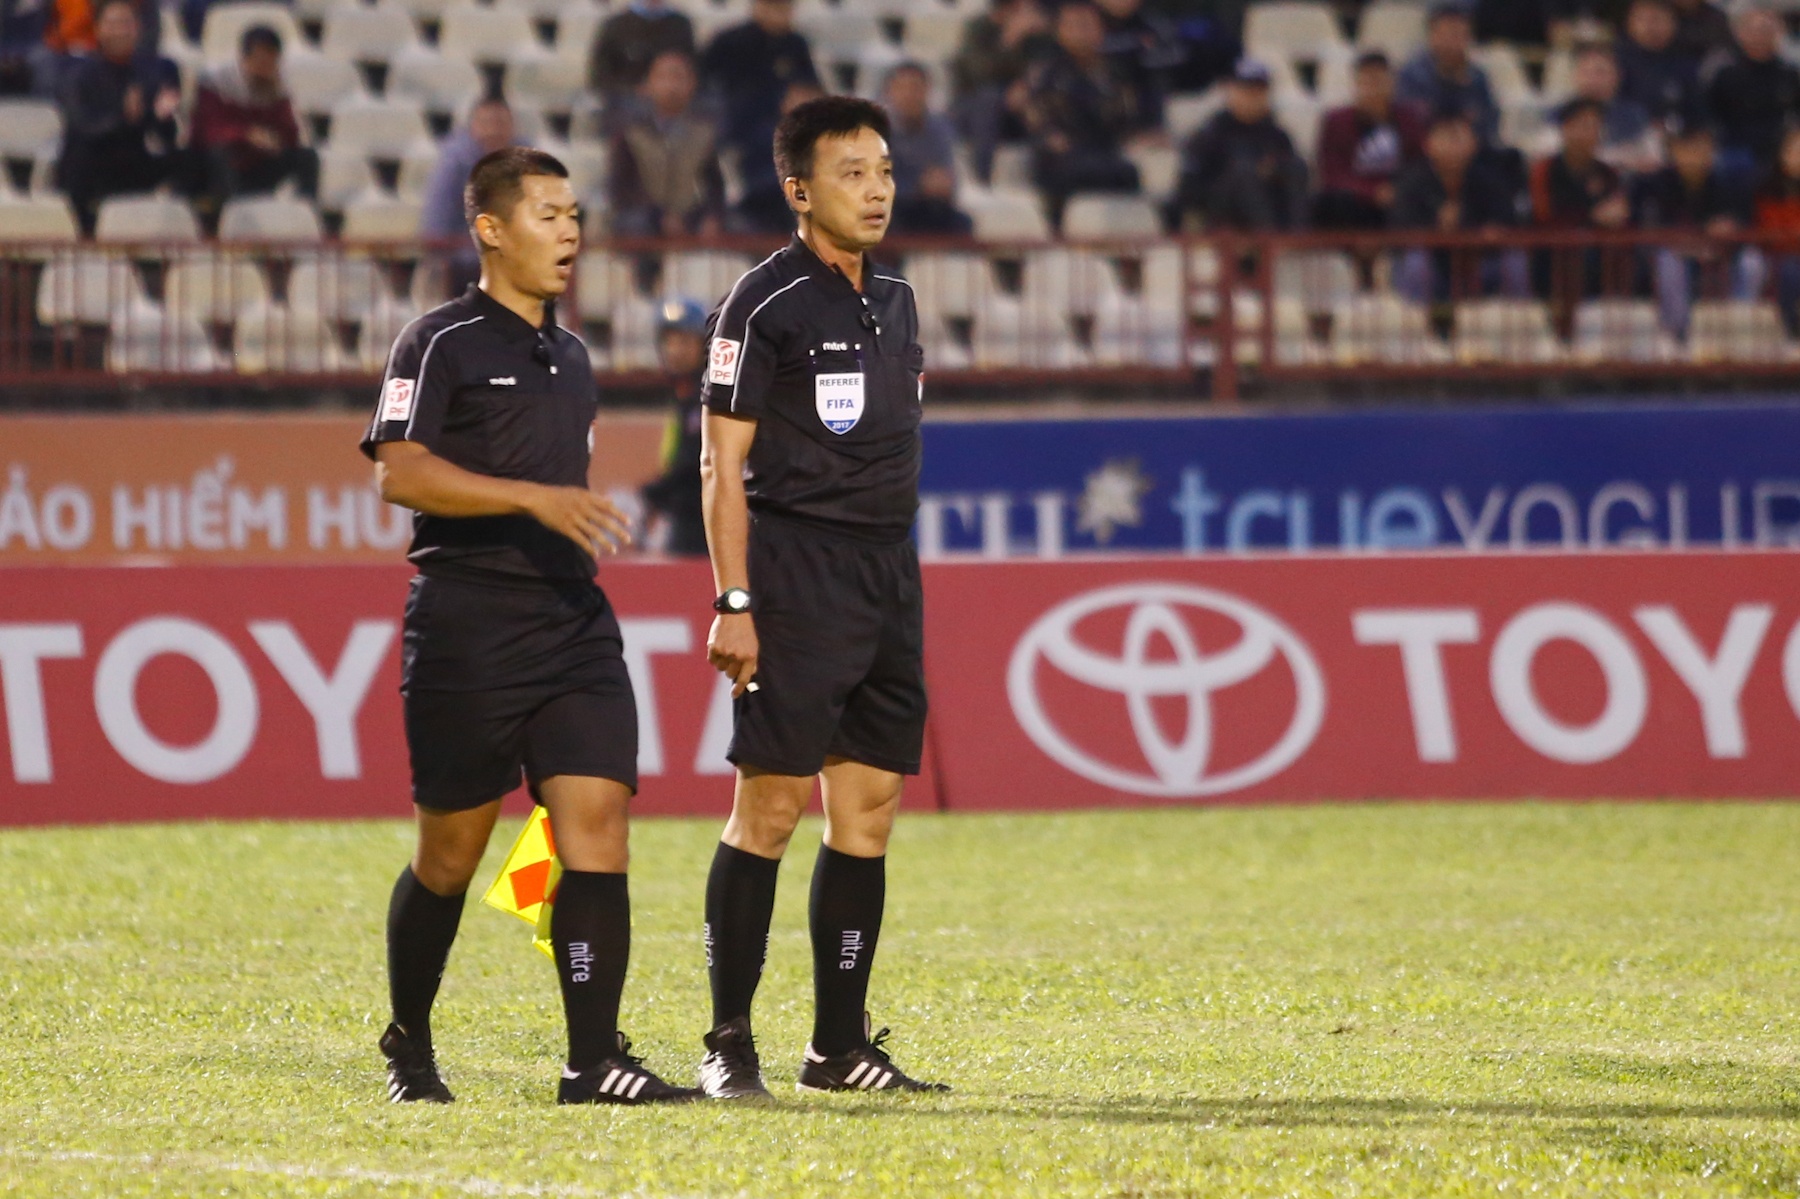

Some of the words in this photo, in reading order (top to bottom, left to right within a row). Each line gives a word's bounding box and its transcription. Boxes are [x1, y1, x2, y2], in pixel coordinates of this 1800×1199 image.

[819, 378, 860, 387] REFEREE
[827, 399, 854, 409] FIFA
[832, 421, 850, 429] 2017
[1353, 602, 1800, 763] TOY
[568, 942, 594, 983] mitre
[839, 930, 864, 970] mitre
